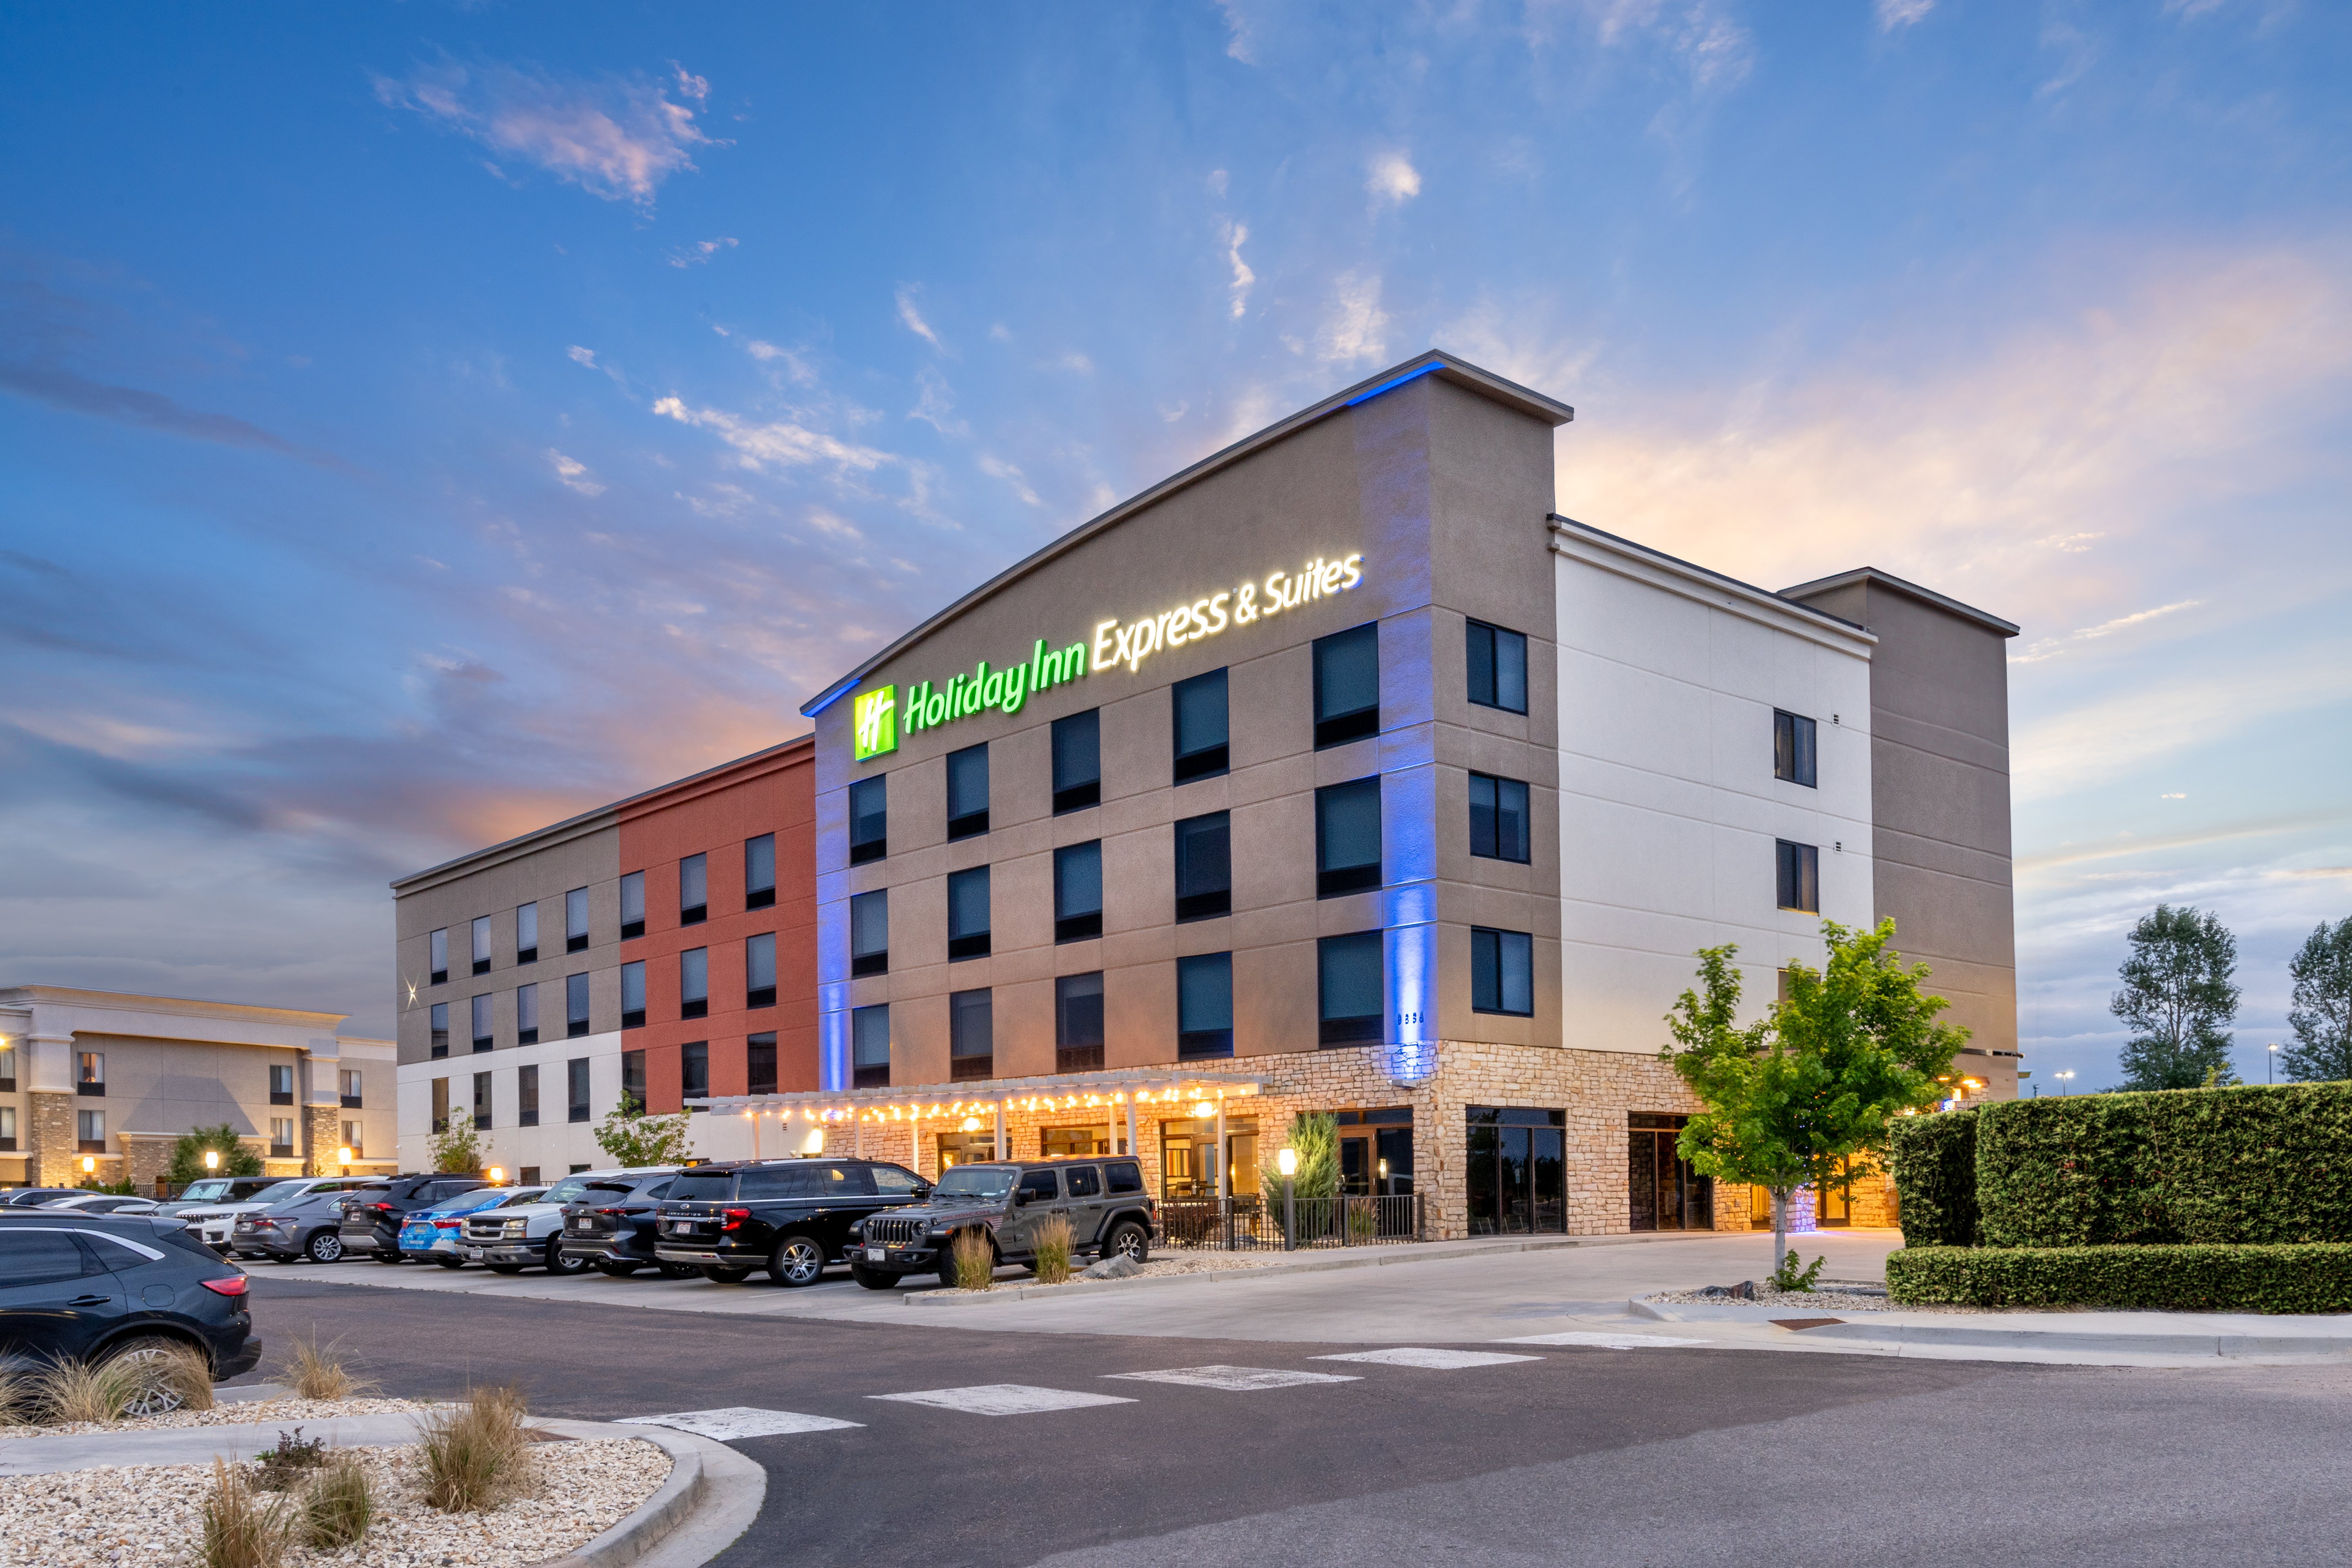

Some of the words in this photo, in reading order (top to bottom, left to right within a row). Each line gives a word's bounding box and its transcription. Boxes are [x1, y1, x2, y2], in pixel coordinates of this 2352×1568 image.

[903, 661, 1030, 734] Holiday
[1030, 639, 1088, 692] Inn
[1092, 593, 1229, 672] Express
[1235, 584, 1257, 624] &
[1263, 555, 1362, 615] Suites
